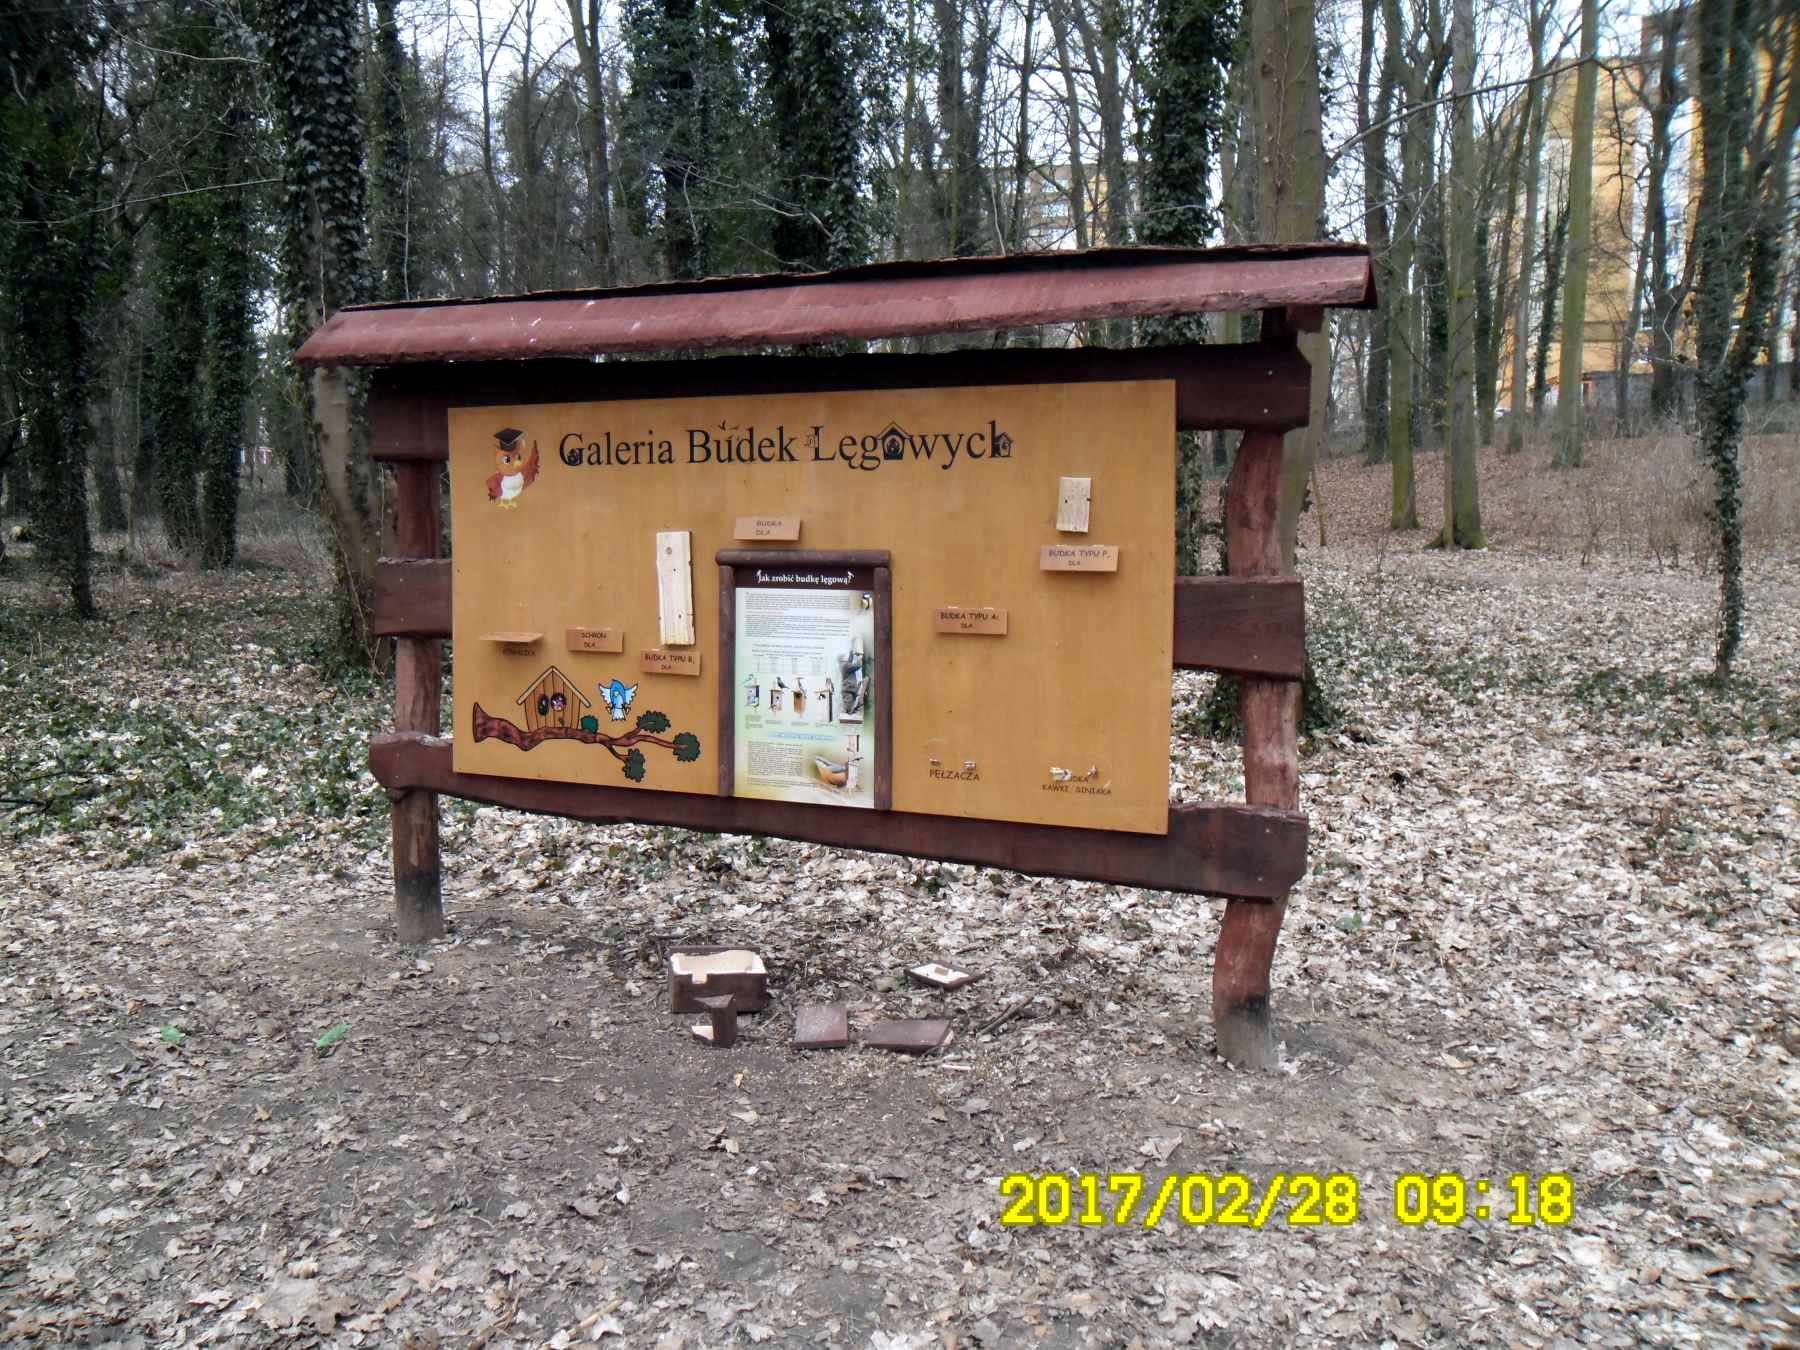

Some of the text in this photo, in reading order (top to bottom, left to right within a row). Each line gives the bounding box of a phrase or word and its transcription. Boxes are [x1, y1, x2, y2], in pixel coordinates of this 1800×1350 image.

[560, 430, 675, 466] Galeria
[686, 425, 799, 464] Budek
[1079, 550, 1100, 558] TYPU
[795, 574, 819, 584] budkę
[940, 612, 966, 620] BUDKA
[968, 612, 988, 620] TYPU
[644, 653, 666, 662] BUDKA
[670, 655, 686, 663] TYPU
